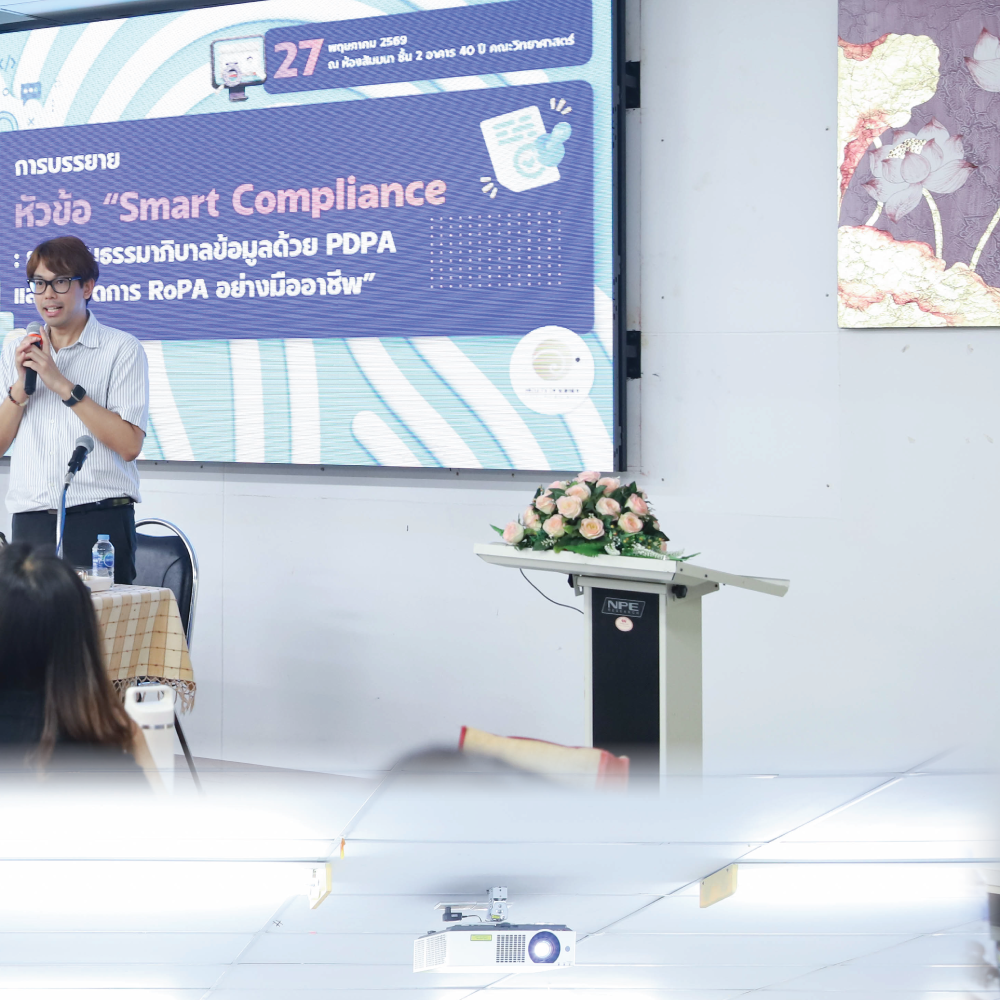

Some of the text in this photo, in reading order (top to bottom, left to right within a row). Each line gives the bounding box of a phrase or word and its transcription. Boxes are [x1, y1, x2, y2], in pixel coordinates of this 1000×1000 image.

[328, 35, 408, 54] พฤษภาคม 2569
[397, 47, 413, 63] ชั้น
[415, 50, 423, 61] 2
[425, 48, 457, 61] อาคาร
[459, 44, 476, 56] 40
[477, 42, 487, 55] ปี
[489, 32, 576, 54] คณะวิทยาศาสตร์
[274, 38, 325, 79] 27
[14, 151, 121, 177] การบรรยาย
[14, 188, 93, 229] หัวข้อ
[231, 174, 448, 219] Compliance
[325, 230, 397, 257] PDPA
[147, 278, 210, 302] RoPA
[607, 600, 640, 612] NPE
